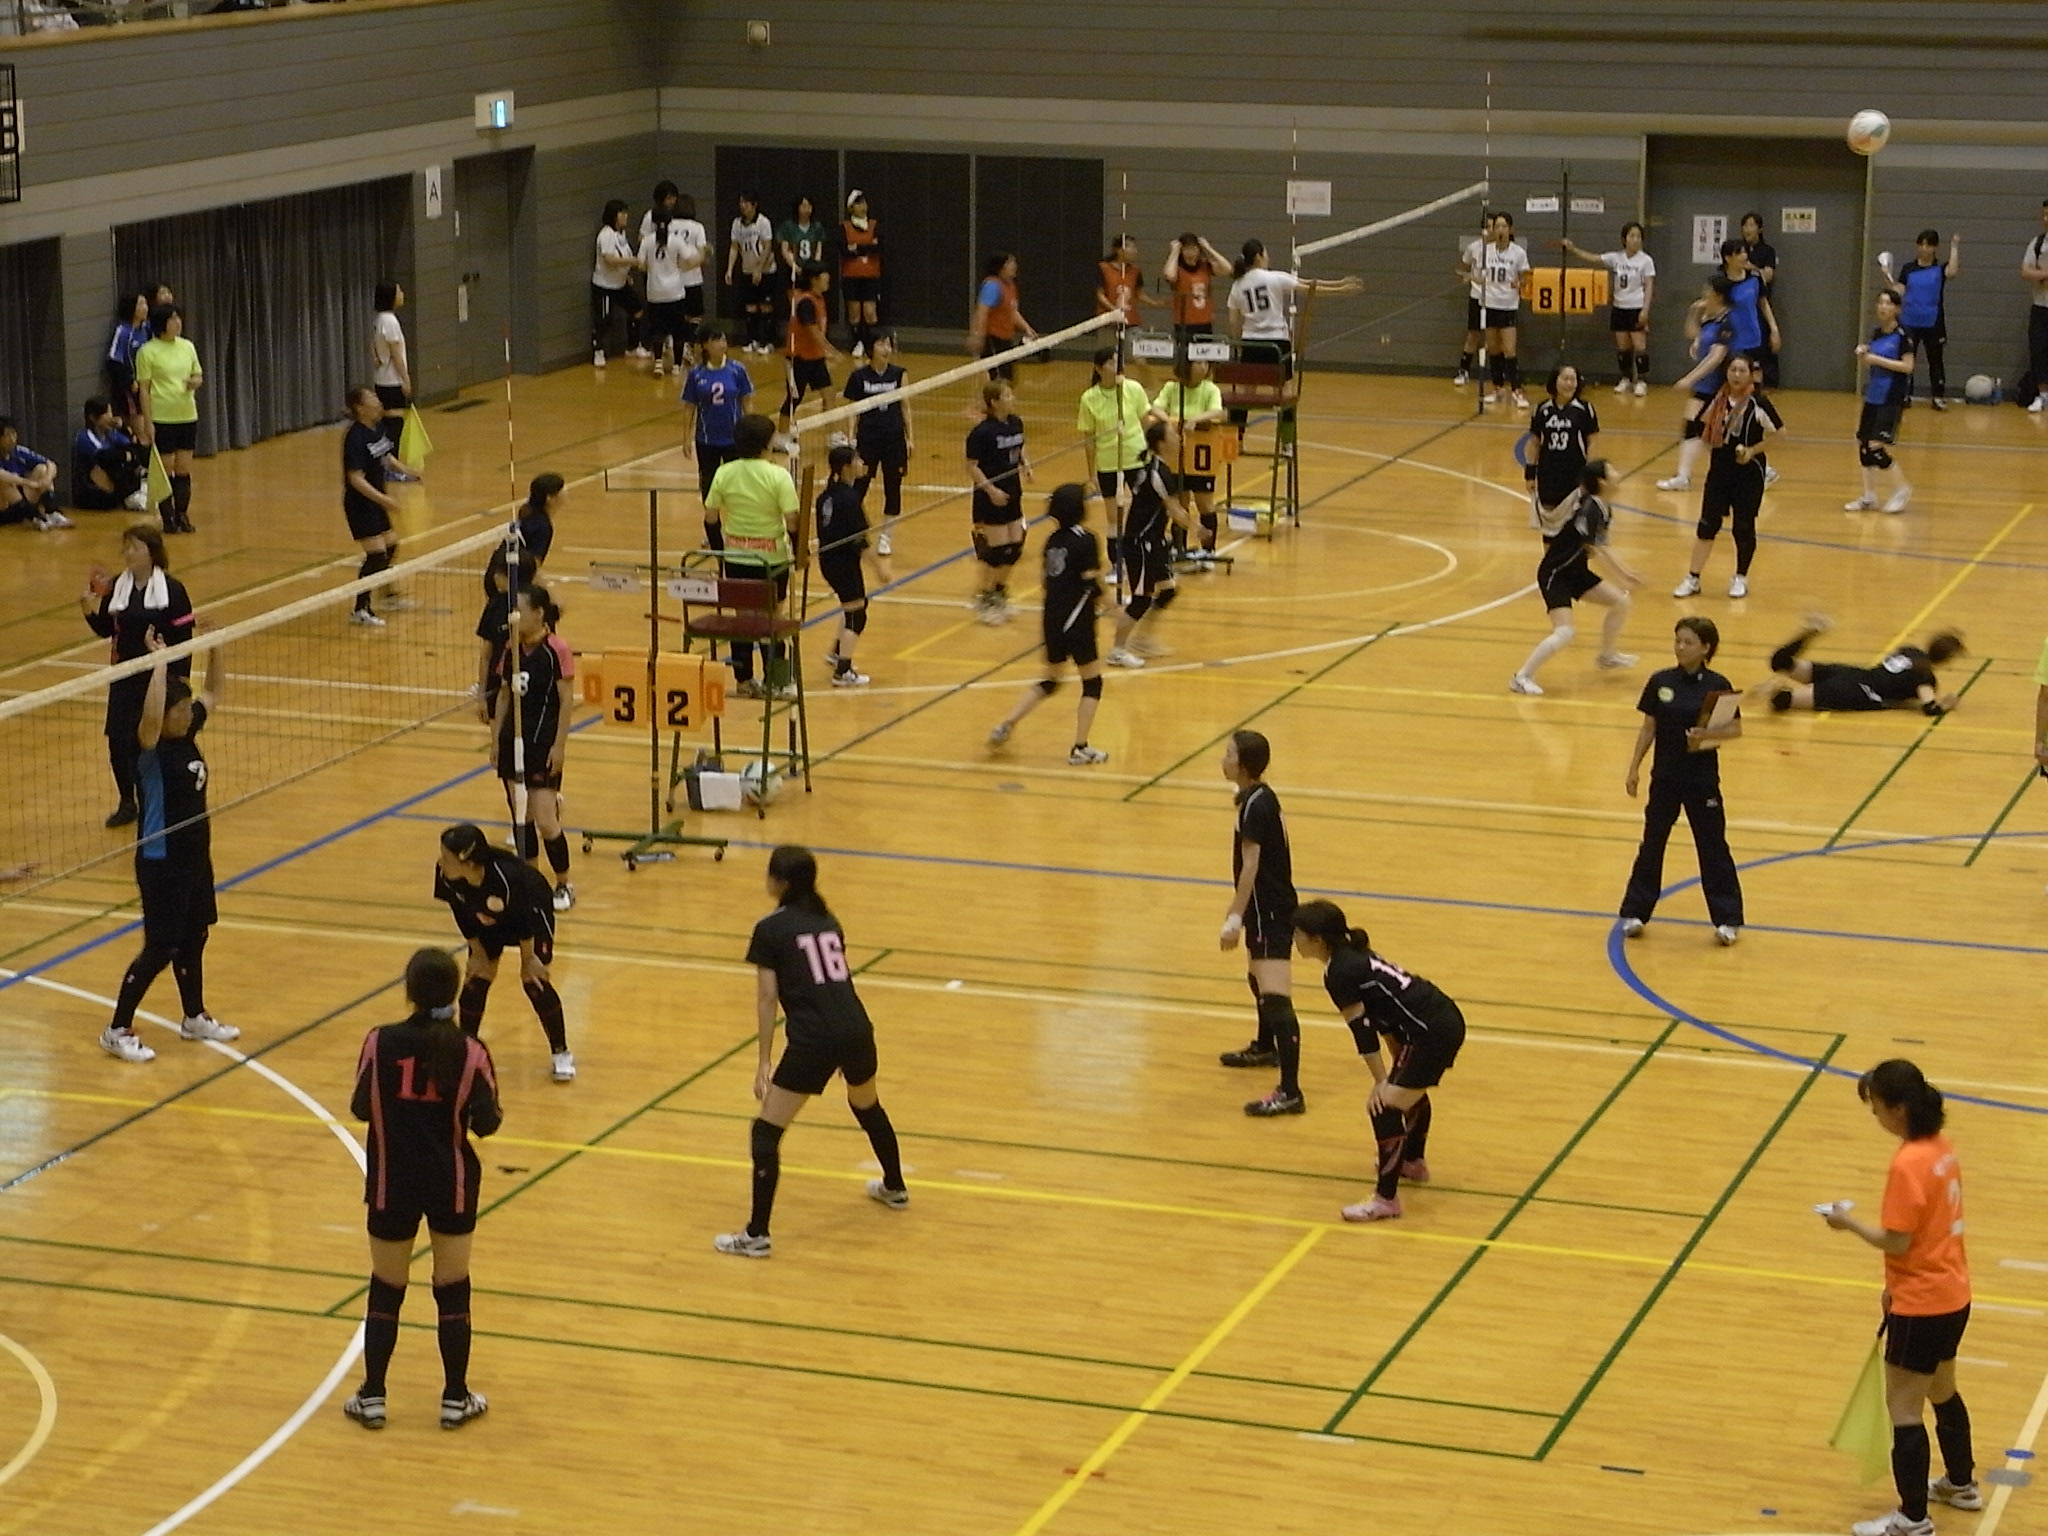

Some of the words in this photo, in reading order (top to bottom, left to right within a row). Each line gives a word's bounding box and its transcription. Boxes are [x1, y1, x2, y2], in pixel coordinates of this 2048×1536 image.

[429, 180, 439, 202] A
[1243, 285, 1270, 313] 15
[1539, 287, 1552, 309] 8
[1570, 287, 1586, 309] 11
[711, 382, 725, 406] 2
[1548, 431, 1569, 451] 33
[1194, 444, 1211, 471] 0
[614, 686, 635, 722] 3
[667, 690, 688, 727] 2
[796, 932, 848, 984] 16
